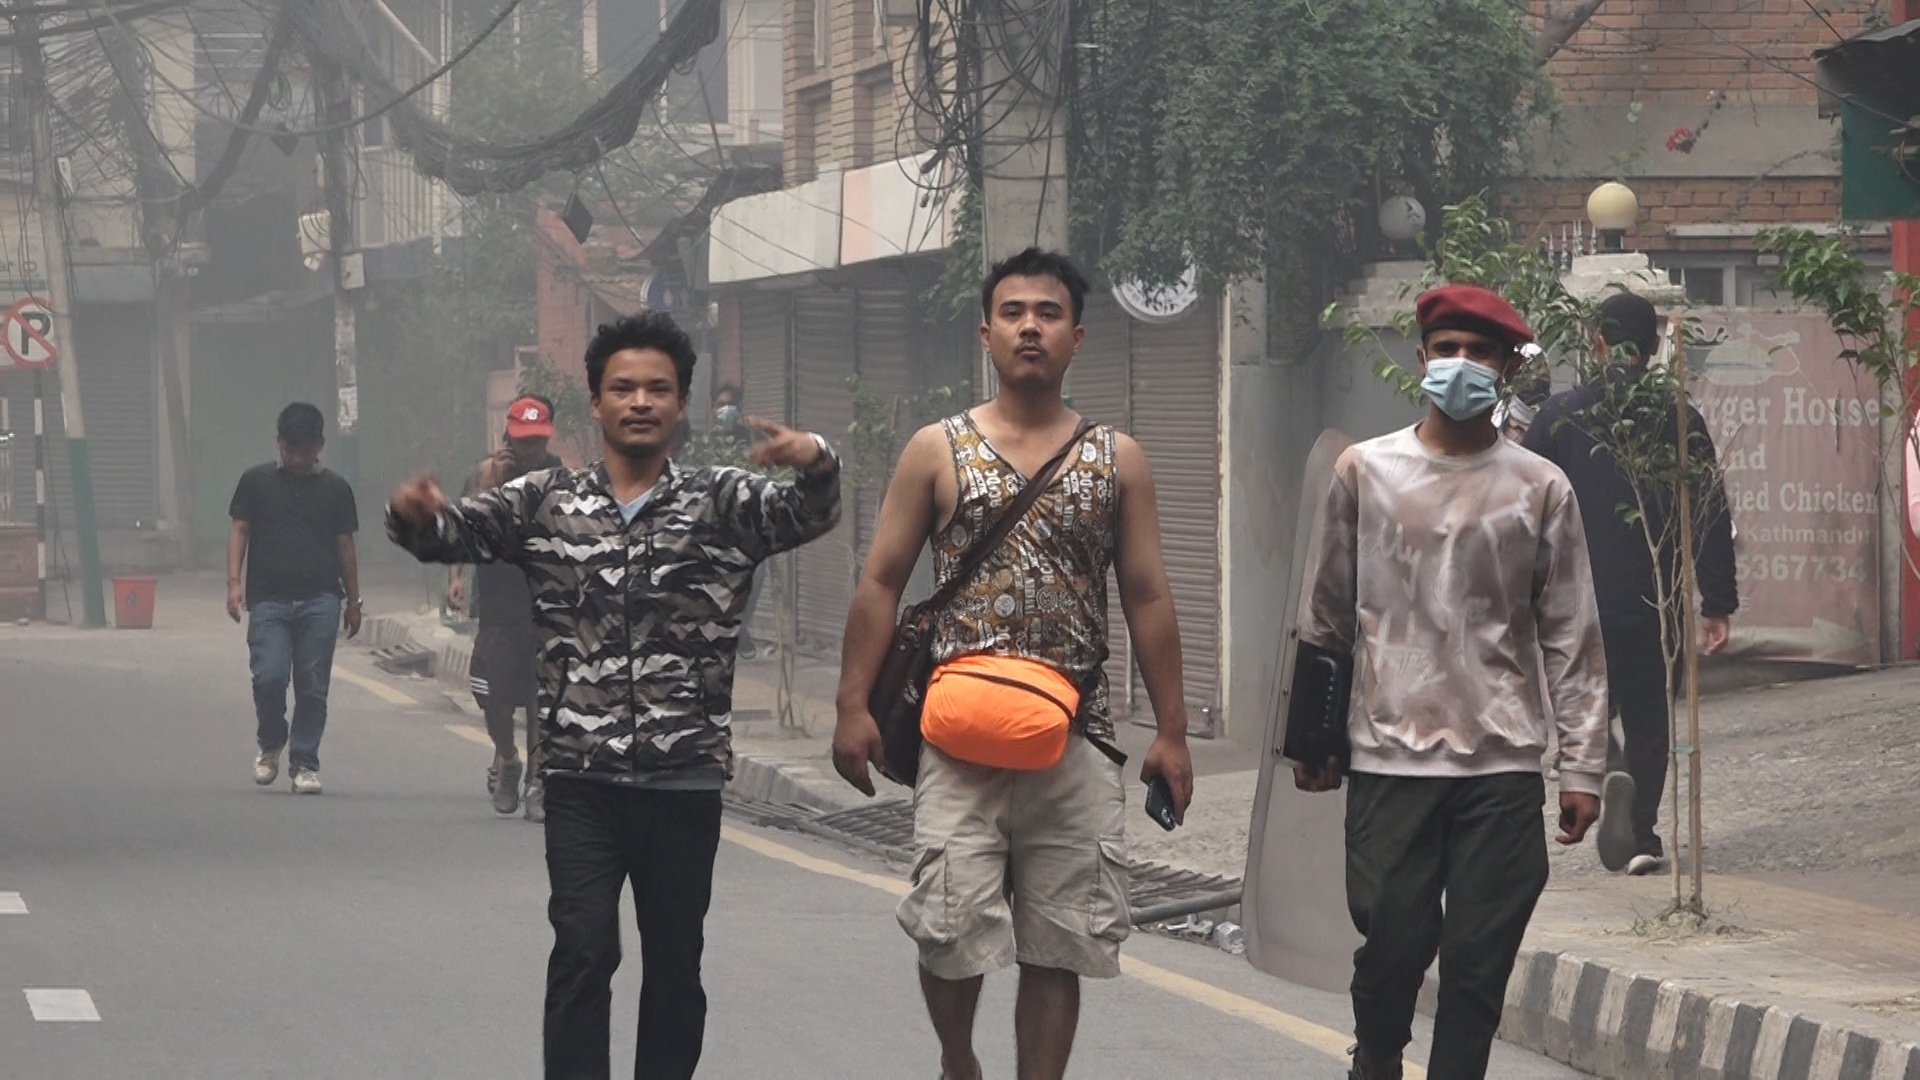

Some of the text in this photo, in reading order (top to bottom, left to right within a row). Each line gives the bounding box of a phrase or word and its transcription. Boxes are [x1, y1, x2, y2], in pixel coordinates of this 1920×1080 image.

[21, 311, 51, 355] P
[1783, 387, 1880, 426] House
[1780, 482, 1879, 514] Chicken
[1744, 524, 1871, 545] Kathmandu
